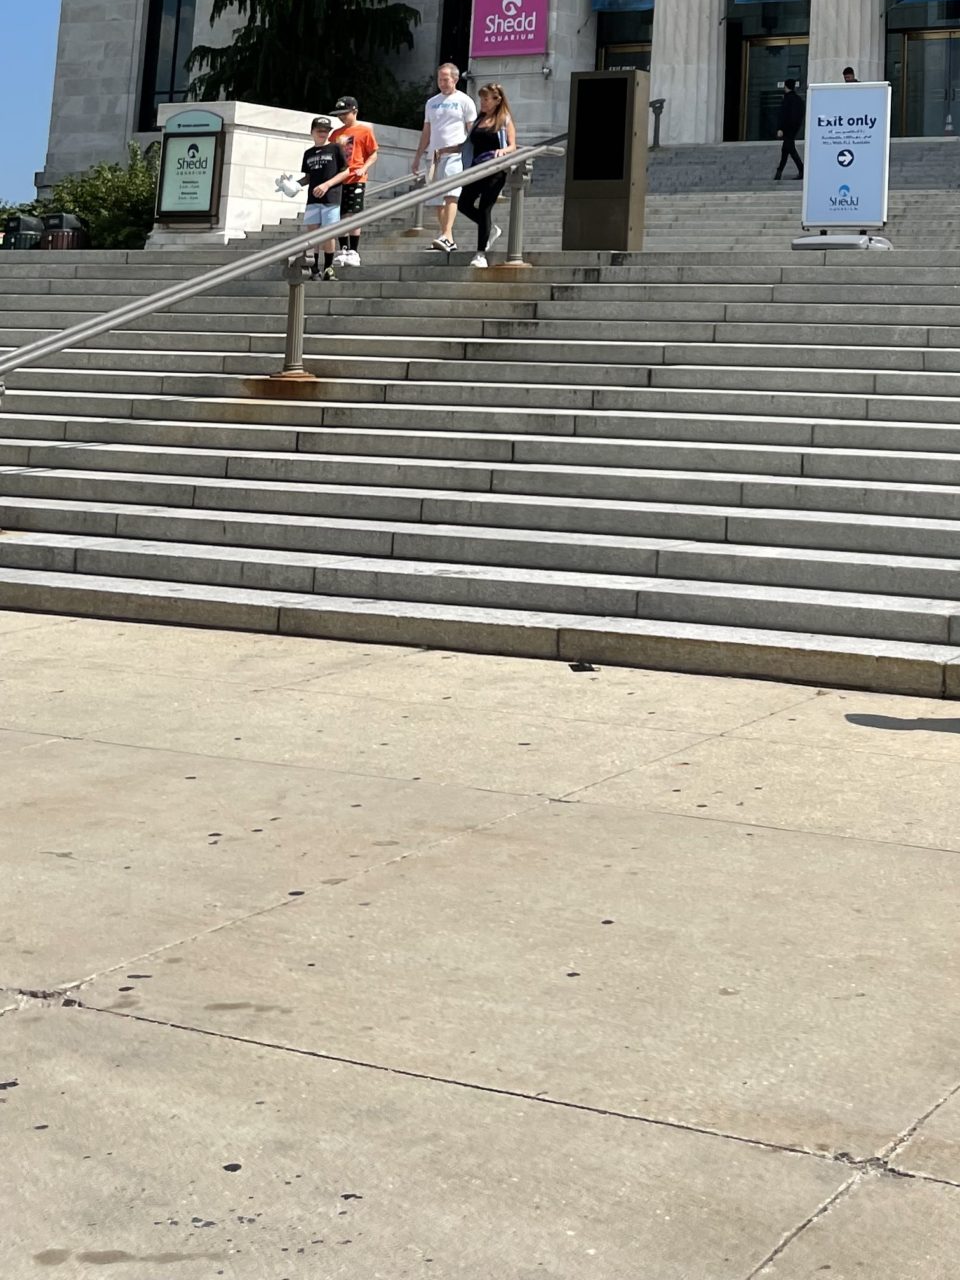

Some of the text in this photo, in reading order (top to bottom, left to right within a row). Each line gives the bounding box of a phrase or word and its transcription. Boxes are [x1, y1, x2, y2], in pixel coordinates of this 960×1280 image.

[484, 11, 537, 34] Shedd
[484, 33, 534, 43] AQUARIUM
[817, 114, 877, 129] Exit only
[176, 156, 208, 170] Shedd
